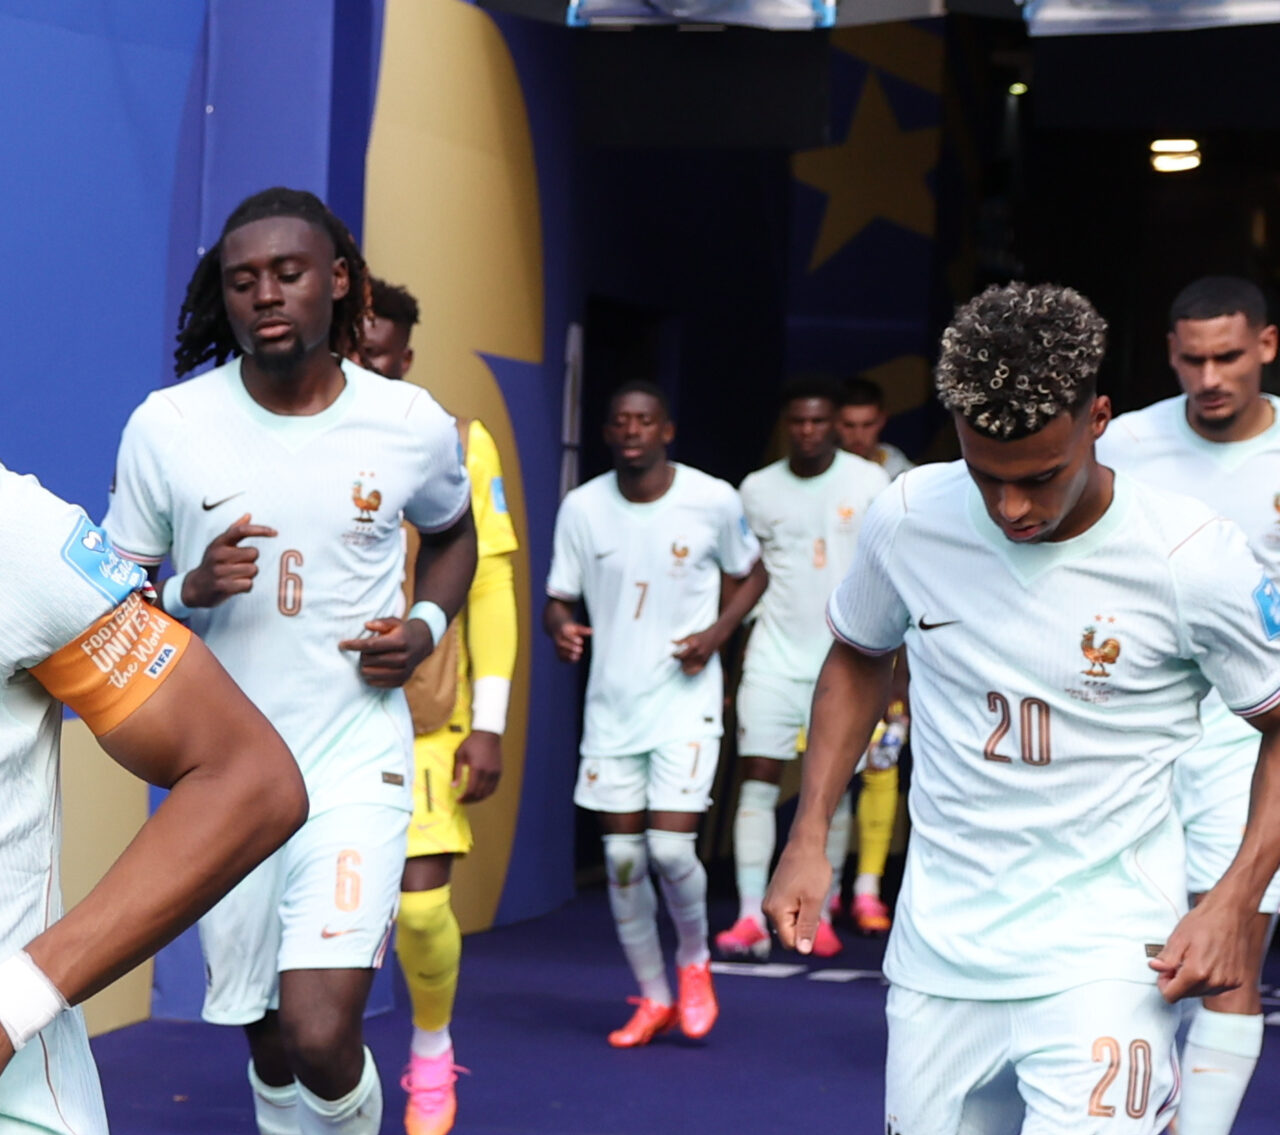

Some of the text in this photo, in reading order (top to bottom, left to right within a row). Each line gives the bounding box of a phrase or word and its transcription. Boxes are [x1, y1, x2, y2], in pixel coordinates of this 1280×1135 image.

[277, 549, 304, 617] 6
[635, 582, 650, 620] 7
[91, 609, 150, 674] UNITES
[107, 614, 171, 689] the World
[148, 648, 174, 675] FIFA
[687, 741, 701, 778] 7
[983, 691, 1051, 766] 20
[334, 848, 363, 912] 6
[1087, 1036, 1152, 1119] 20
